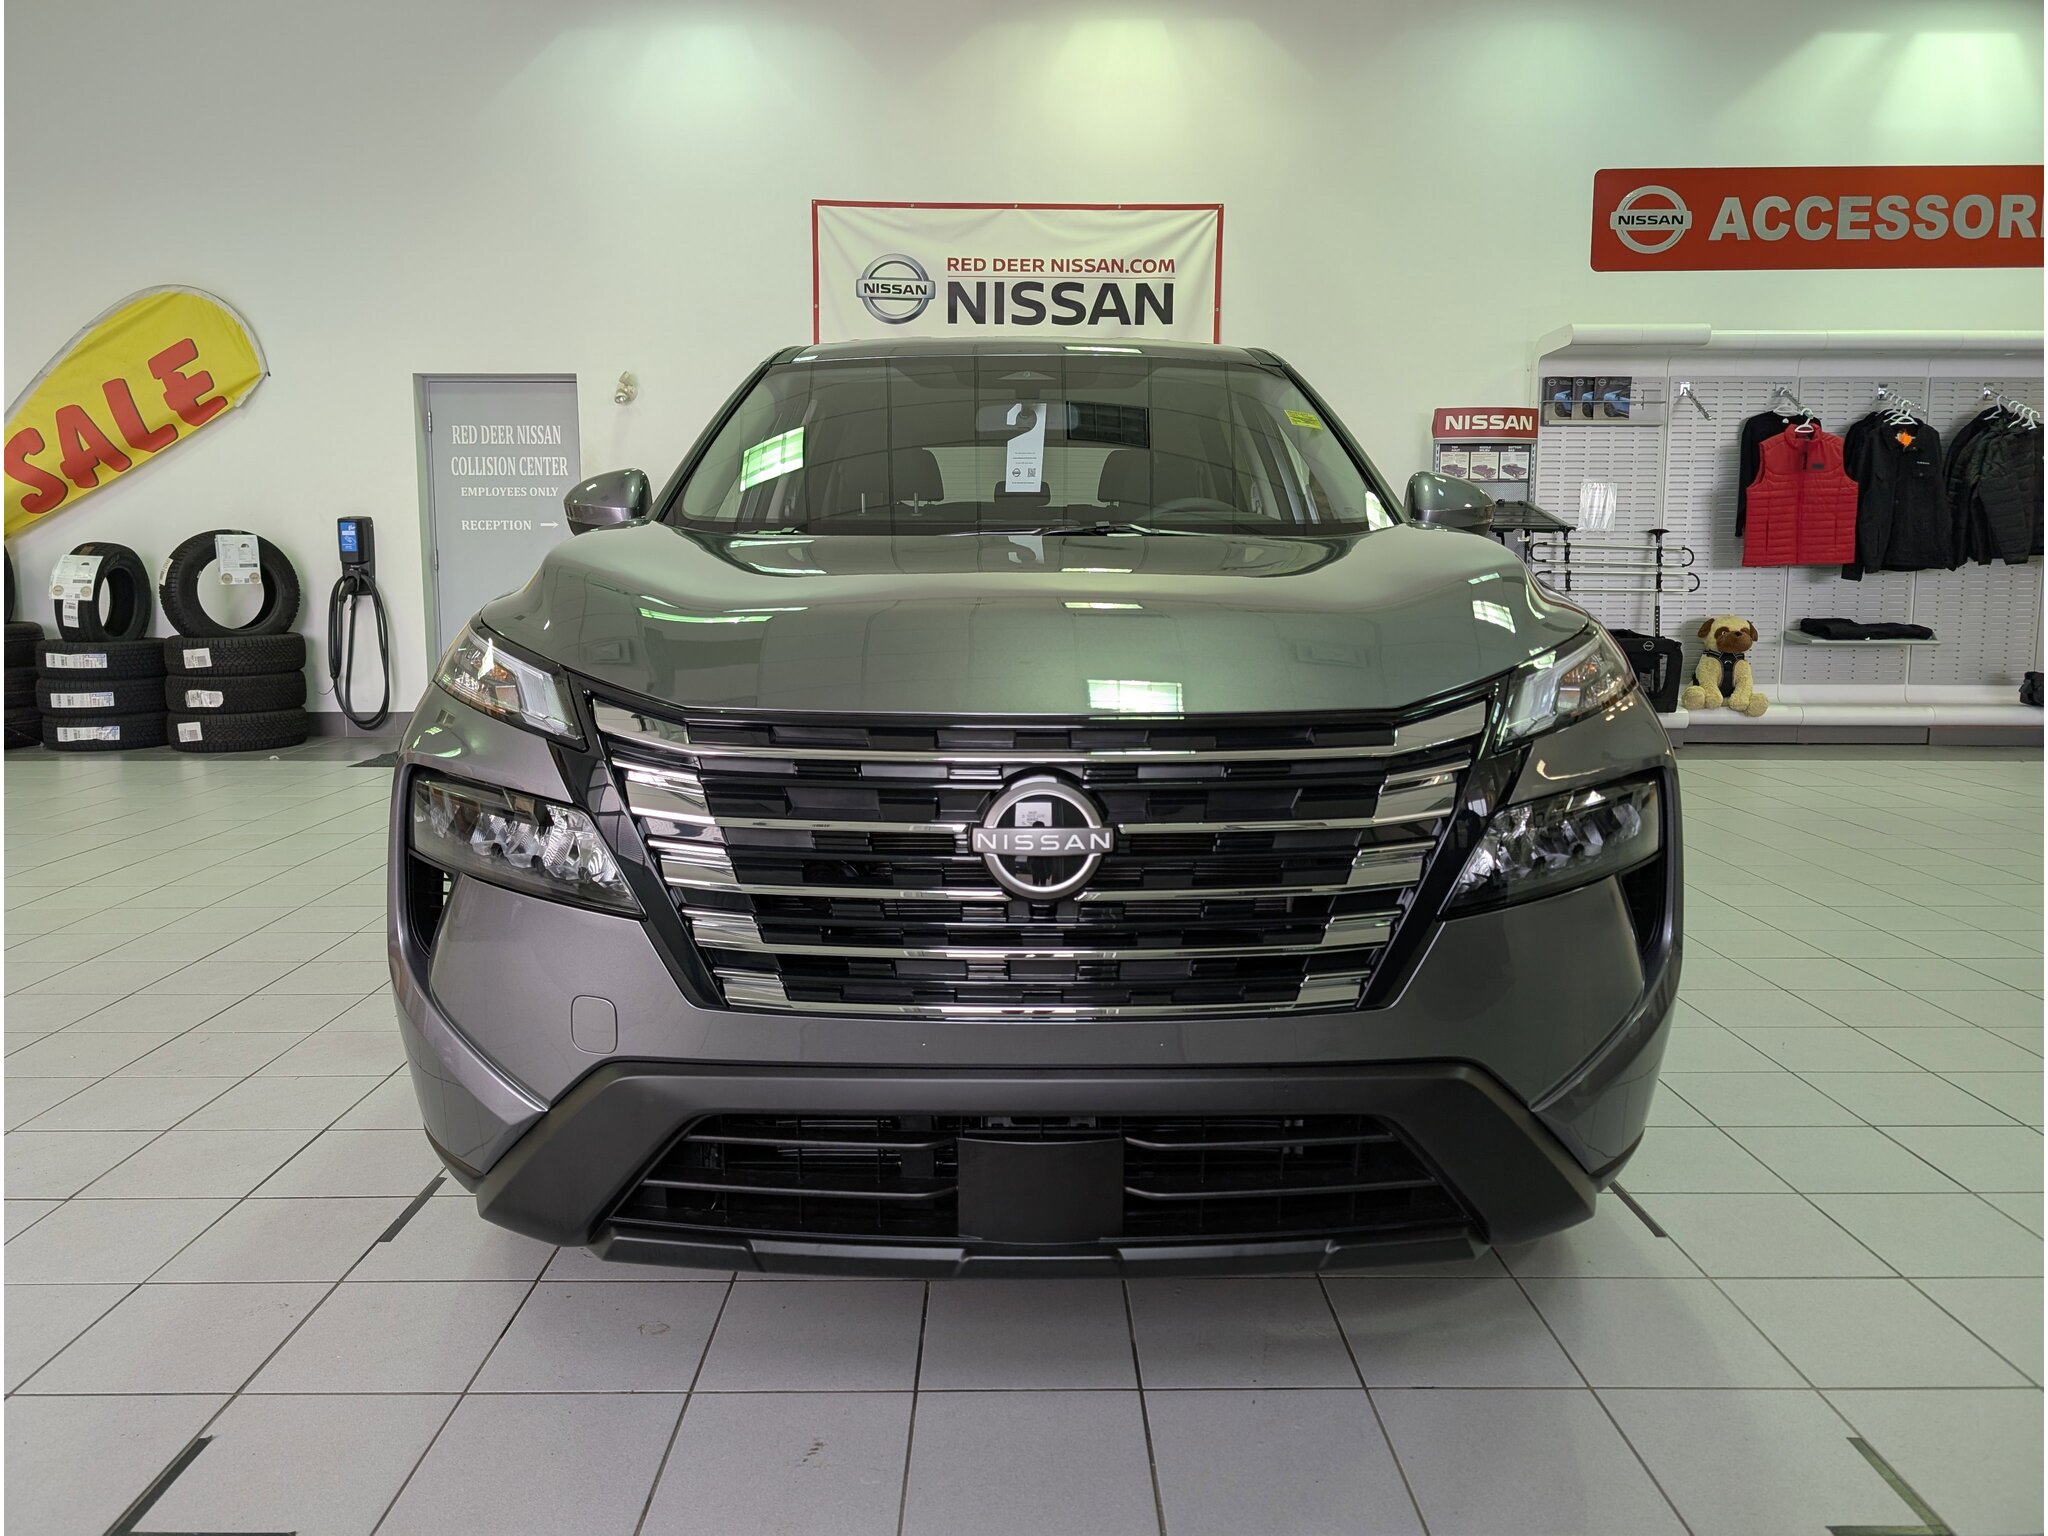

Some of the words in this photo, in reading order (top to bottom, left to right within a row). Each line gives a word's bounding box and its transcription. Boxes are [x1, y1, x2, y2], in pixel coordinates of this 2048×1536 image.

[1617, 213, 1685, 228] NISSAN
[1707, 194, 2044, 242] ACCESSOR
[946, 256, 987, 273] RED
[992, 258, 1044, 273] DEER
[1050, 258, 1176, 274] NISSAN.COM
[863, 282, 928, 297] NISSAN
[946, 280, 1174, 326] NISSAN
[4, 337, 229, 514] SALE
[1444, 414, 1533, 431] NISSAN
[451, 425, 478, 445] RED
[480, 425, 515, 445] DEER
[517, 425, 562, 445] NISSAN
[451, 456, 516, 476] COLLISION
[519, 456, 569, 476] CENTER
[460, 487, 527, 497] EMPLOYEES
[529, 487, 559, 497] ONLY
[461, 520, 532, 531] RECEPTION
[977, 832, 1110, 850] NISSAN
